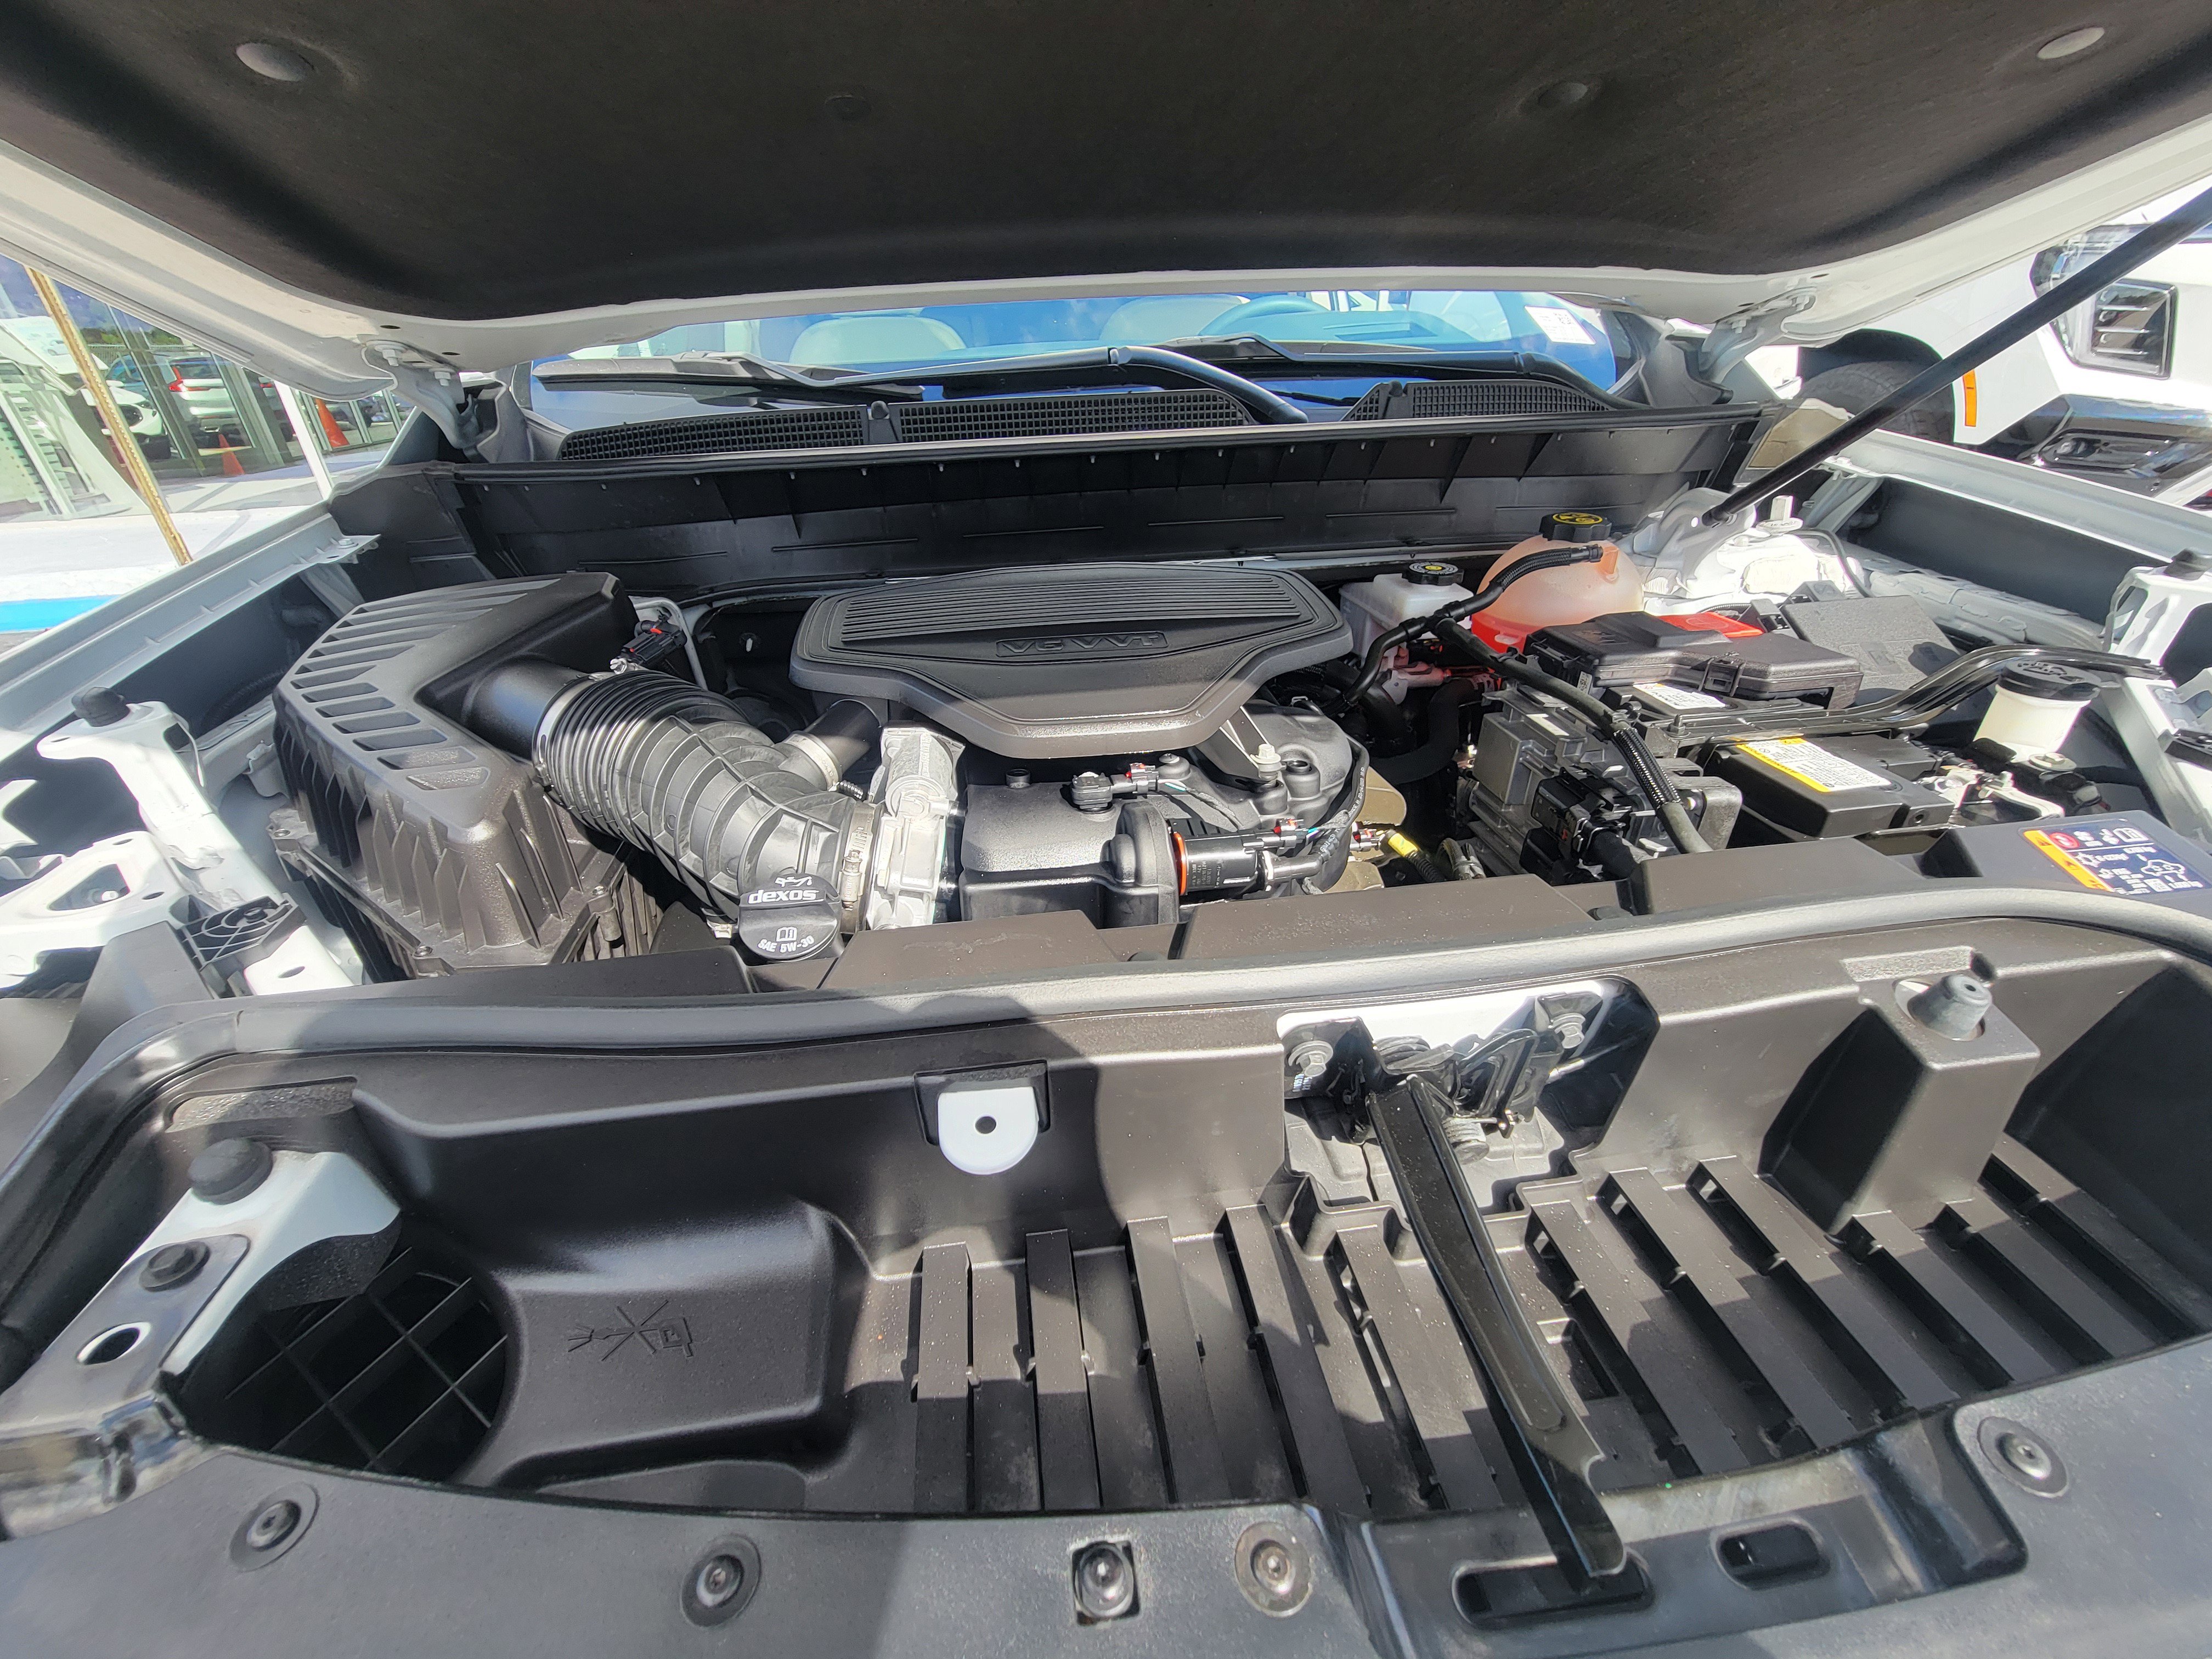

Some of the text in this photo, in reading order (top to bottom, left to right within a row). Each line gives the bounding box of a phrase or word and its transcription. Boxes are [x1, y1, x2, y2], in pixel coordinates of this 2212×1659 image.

[1002, 635, 1159, 653] V6 VVT
[748, 889, 819, 904] dexos
[758, 935, 815, 953] SAE 5W-30
